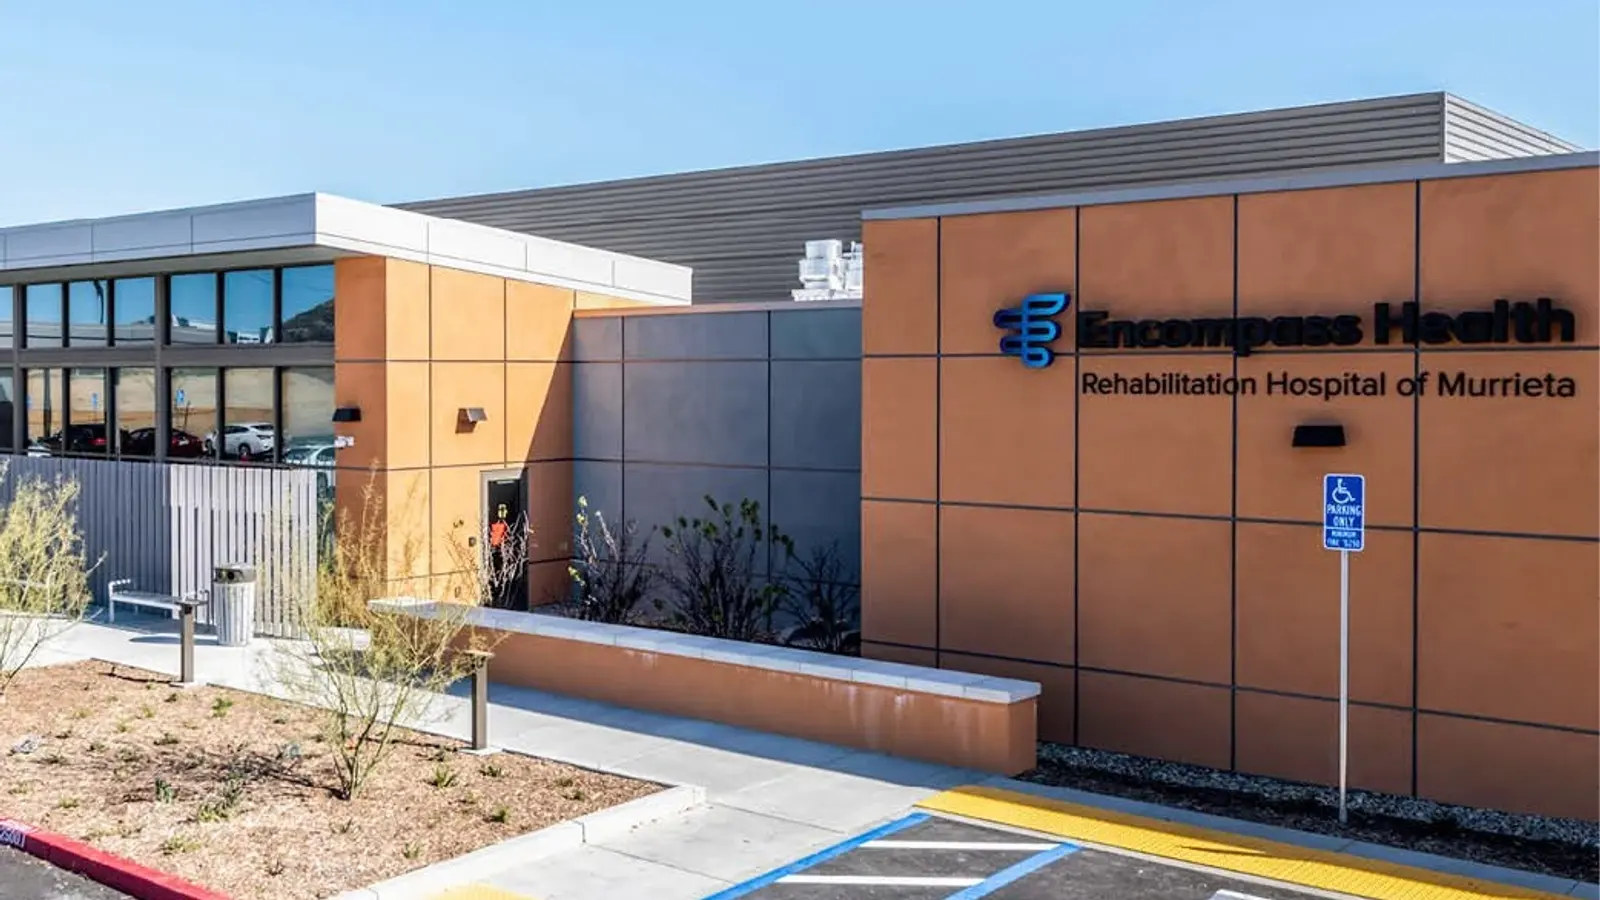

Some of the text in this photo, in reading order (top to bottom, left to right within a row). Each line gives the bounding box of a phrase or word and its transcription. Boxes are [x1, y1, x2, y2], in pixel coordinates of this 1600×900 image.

[1078, 297, 1575, 357] Encompass Health
[1082, 372, 1576, 401] Rehabilitation Hospital of Murrieta
[1327, 504, 1361, 516] PARKING
[1333, 516, 1355, 527] ONLY
